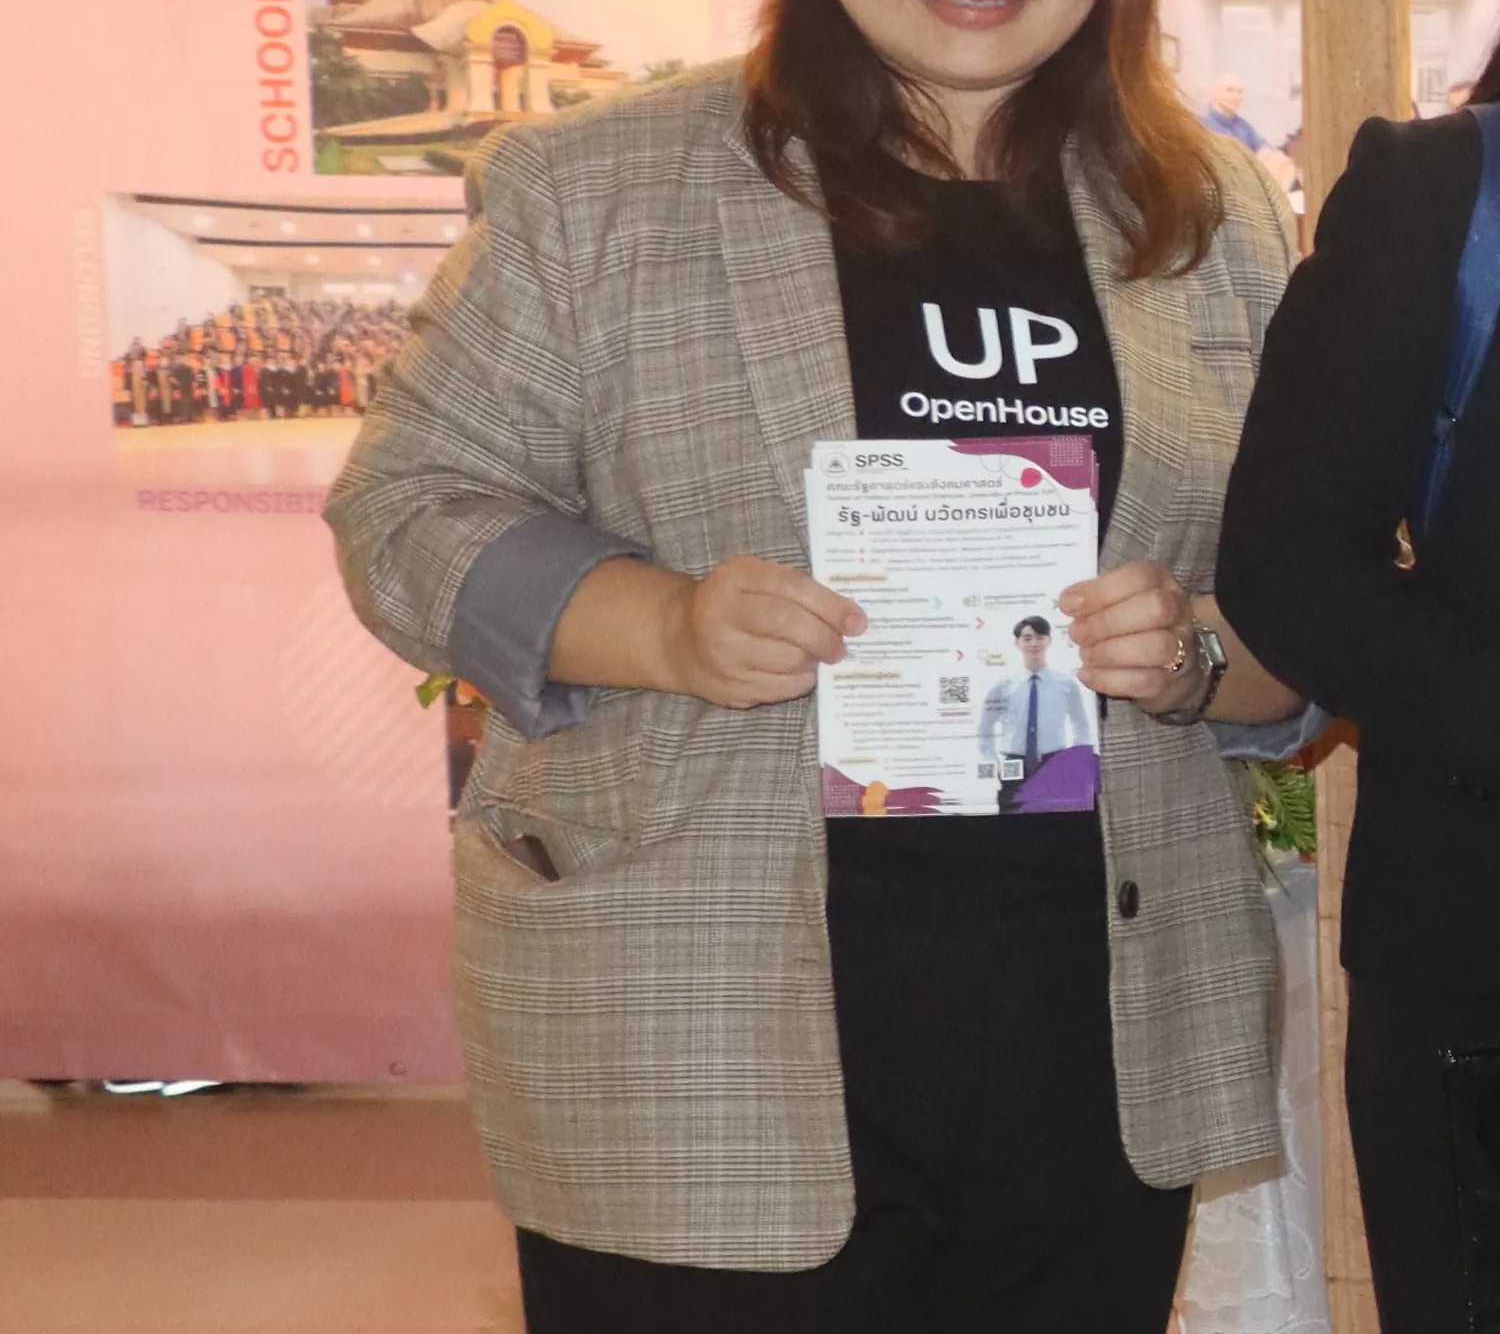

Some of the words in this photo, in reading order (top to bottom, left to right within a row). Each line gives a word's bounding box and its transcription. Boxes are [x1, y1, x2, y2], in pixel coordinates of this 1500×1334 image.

[922, 302, 1079, 385] UP
[900, 391, 1109, 429] OpenHouse
[855, 454, 905, 469] SPSS
[838, 504, 918, 528] รัฐ-พัฒน์
